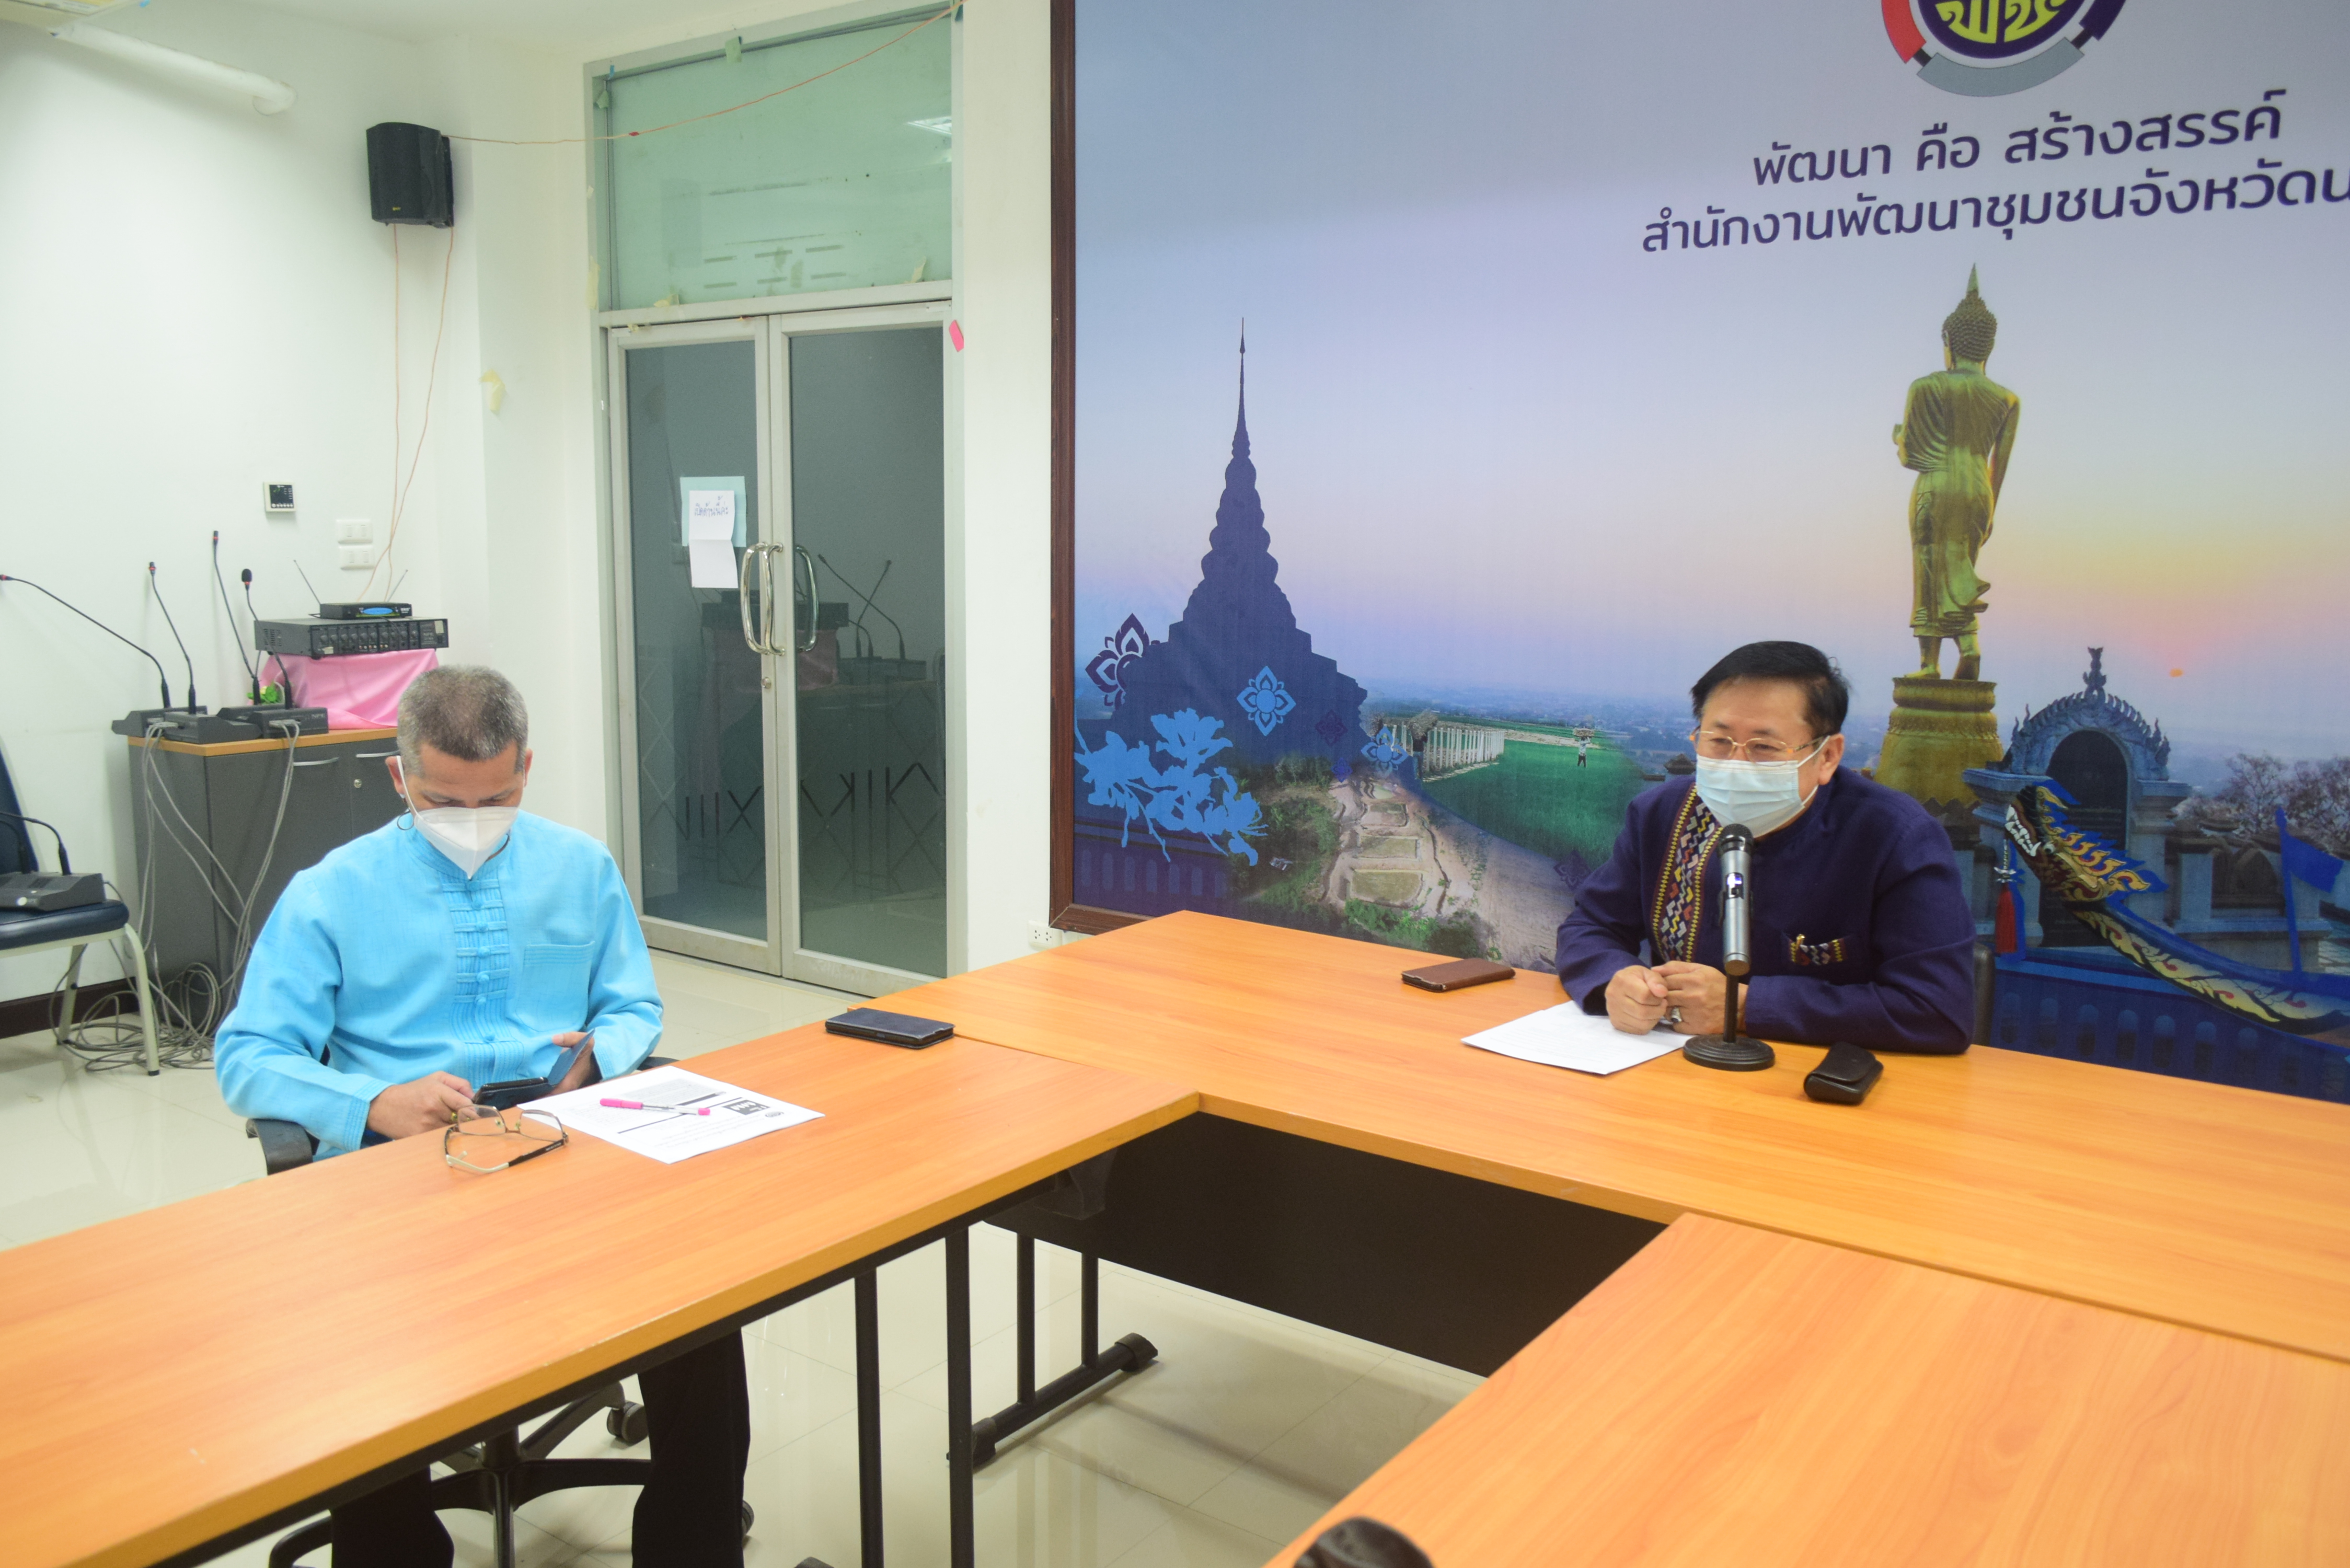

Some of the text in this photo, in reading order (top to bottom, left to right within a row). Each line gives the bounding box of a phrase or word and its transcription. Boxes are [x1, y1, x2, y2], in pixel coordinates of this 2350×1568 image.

[1753, 88, 2287, 186] พัฒนา คือ สร้างสรรค์
